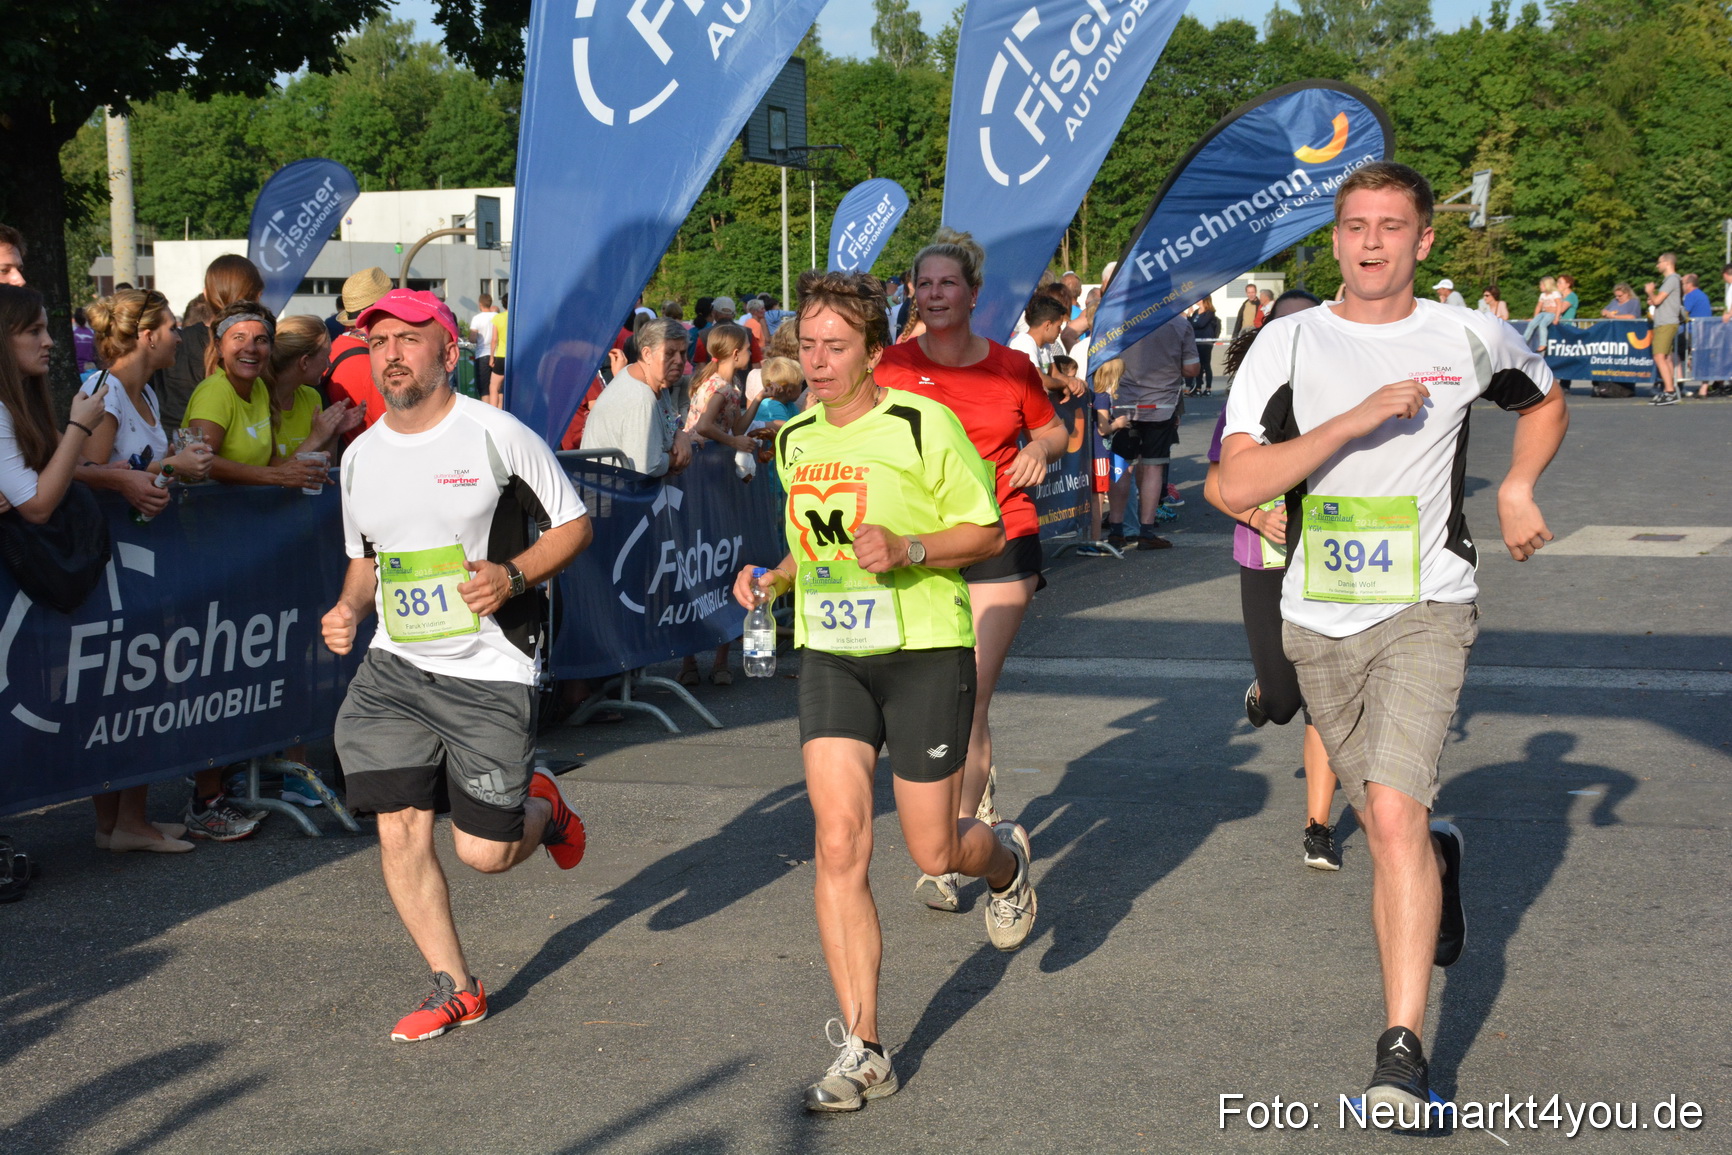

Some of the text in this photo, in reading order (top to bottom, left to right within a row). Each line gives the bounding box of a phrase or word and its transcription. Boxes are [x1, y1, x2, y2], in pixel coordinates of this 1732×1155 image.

[1249, 154, 1376, 234] Druck und Medien
[274, 176, 335, 258] Fischer
[296, 192, 342, 257] AUTOMOBILE
[848, 193, 891, 260] Fischer
[862, 205, 897, 258] AUTOMOBILE
[1135, 167, 1313, 282] Frischmann
[1547, 339, 1629, 357] Frischmann
[1590, 356, 1654, 367] Druck und Medien
[1421, 375, 1463, 383] partner
[443, 477, 480, 485] partner
[792, 462, 870, 483] Müller
[804, 509, 853, 546] M
[1355, 519, 1378, 527] 2016
[414, 568, 433, 576] 2016
[1323, 538, 1393, 573] 394
[394, 584, 448, 617] 381
[844, 580, 863, 588] 2016
[1338, 580, 1358, 588] Daniel
[819, 599, 876, 630] 337
[65, 600, 299, 704] Fischer
[84, 678, 285, 750] AUTOMOBILE
